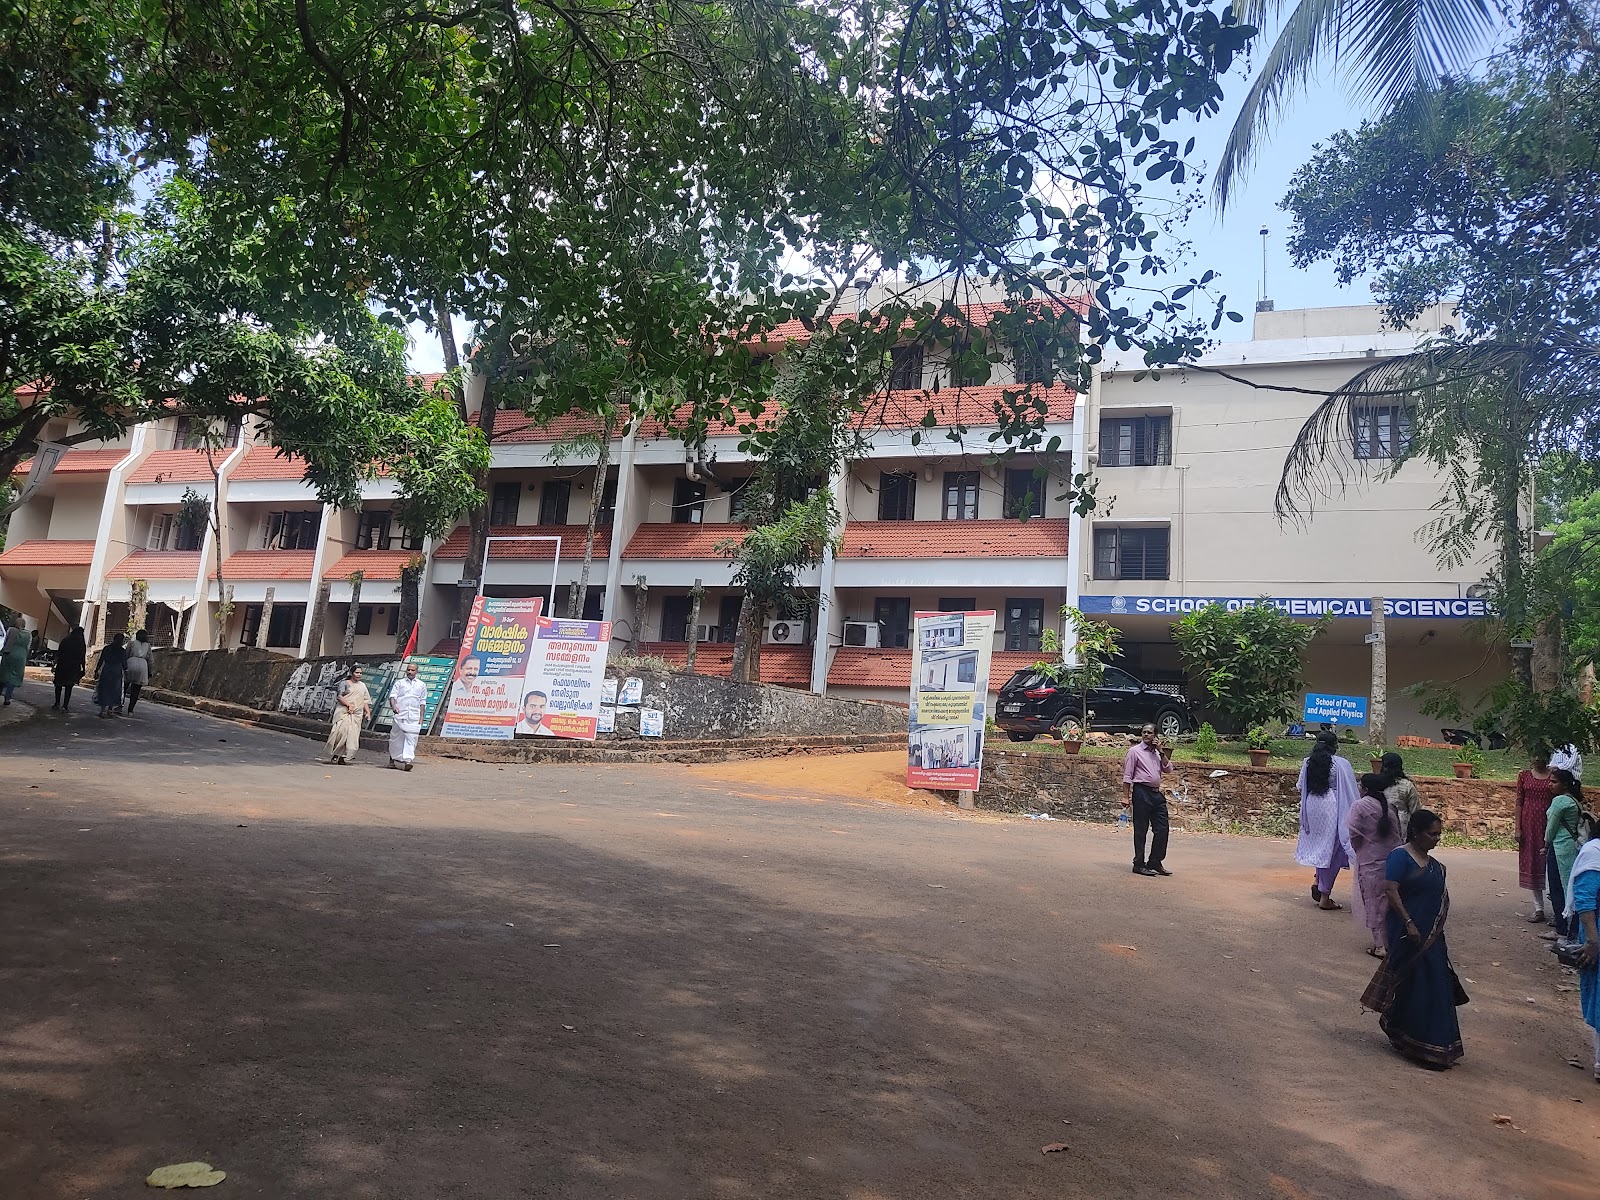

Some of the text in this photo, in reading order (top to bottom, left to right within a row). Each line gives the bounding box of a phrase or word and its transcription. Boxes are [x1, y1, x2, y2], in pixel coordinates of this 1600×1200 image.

[1136, 598, 1214, 613] SCHOO
[463, 599, 485, 650] MGUEA
[477, 639, 526, 654] സമ്മേളനം
[547, 642, 598, 653] അനുബന്ധ
[545, 652, 591, 664] സമ്മേളനം
[1315, 697, 1357, 708] School of Pure
[1307, 707, 1364, 719] and Applied Physics
